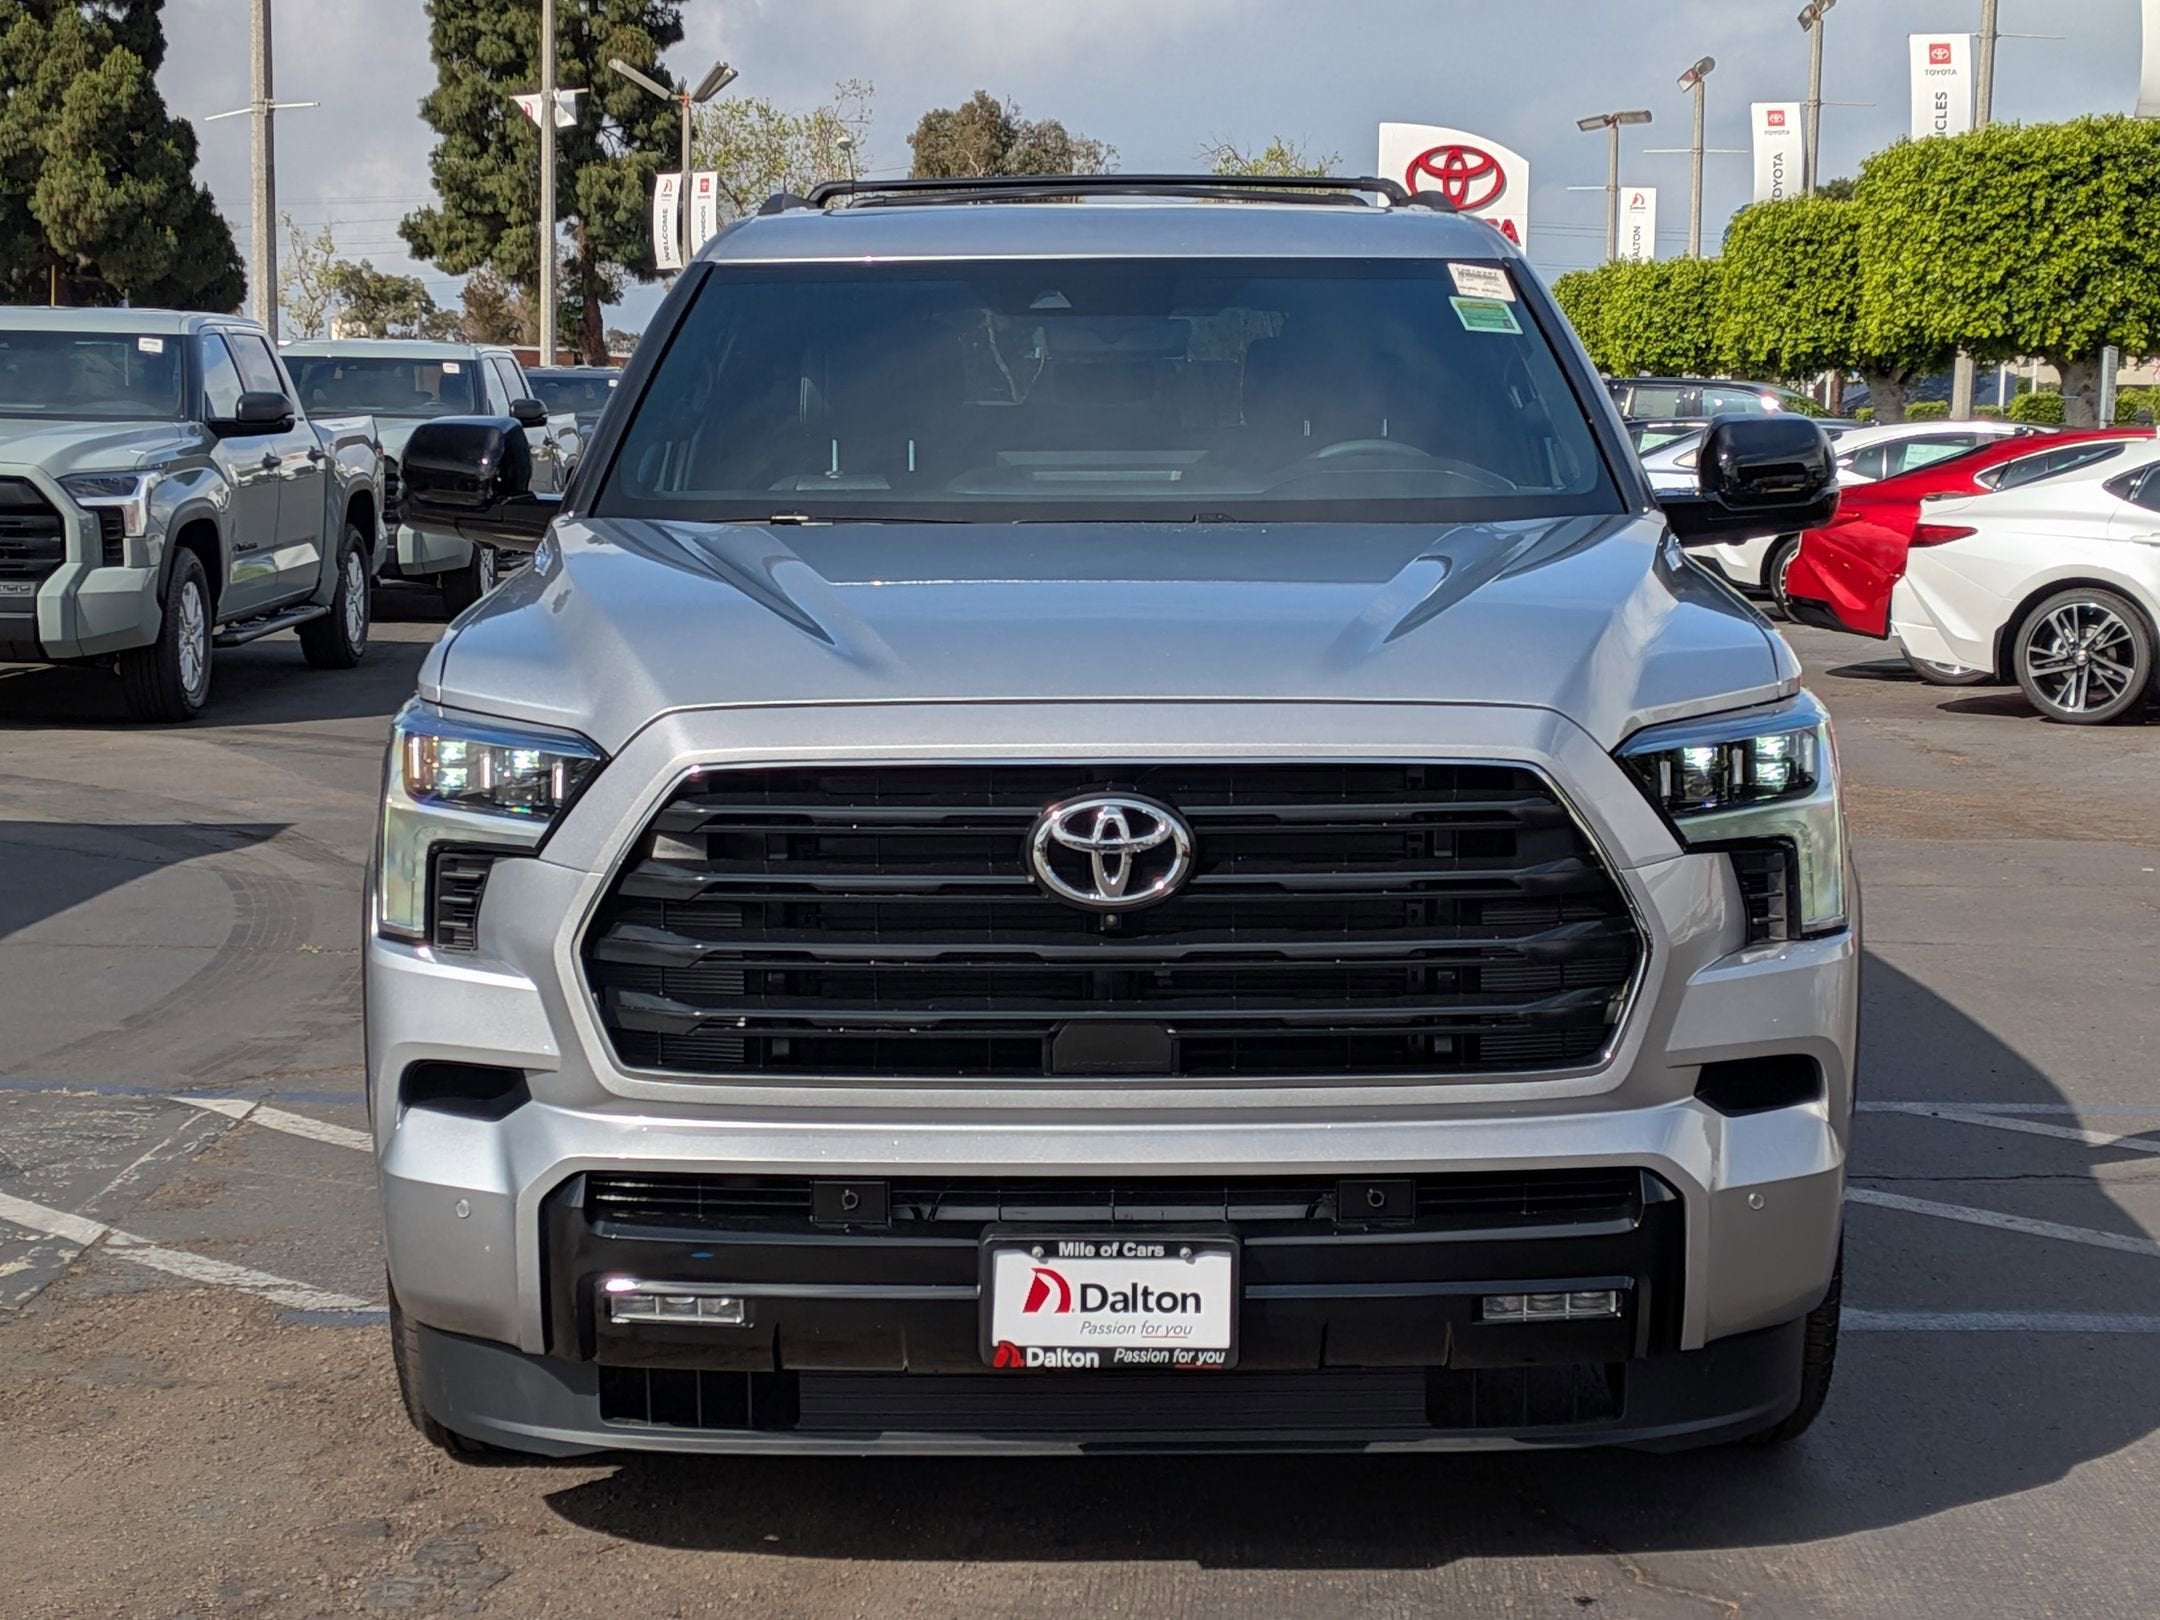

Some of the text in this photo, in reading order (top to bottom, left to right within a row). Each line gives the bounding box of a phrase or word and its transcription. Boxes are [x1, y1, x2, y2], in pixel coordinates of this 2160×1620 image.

[1773, 152, 1783, 200] OYOTA
[662, 208, 671, 261] WELCOME
[1058, 1241, 1165, 1257] Mile of Cars
[1080, 1282, 1201, 1314] Dalton
[1080, 1320, 1193, 1338] Passion for you
[1026, 1347, 1225, 1368] Dalton Passion for you
